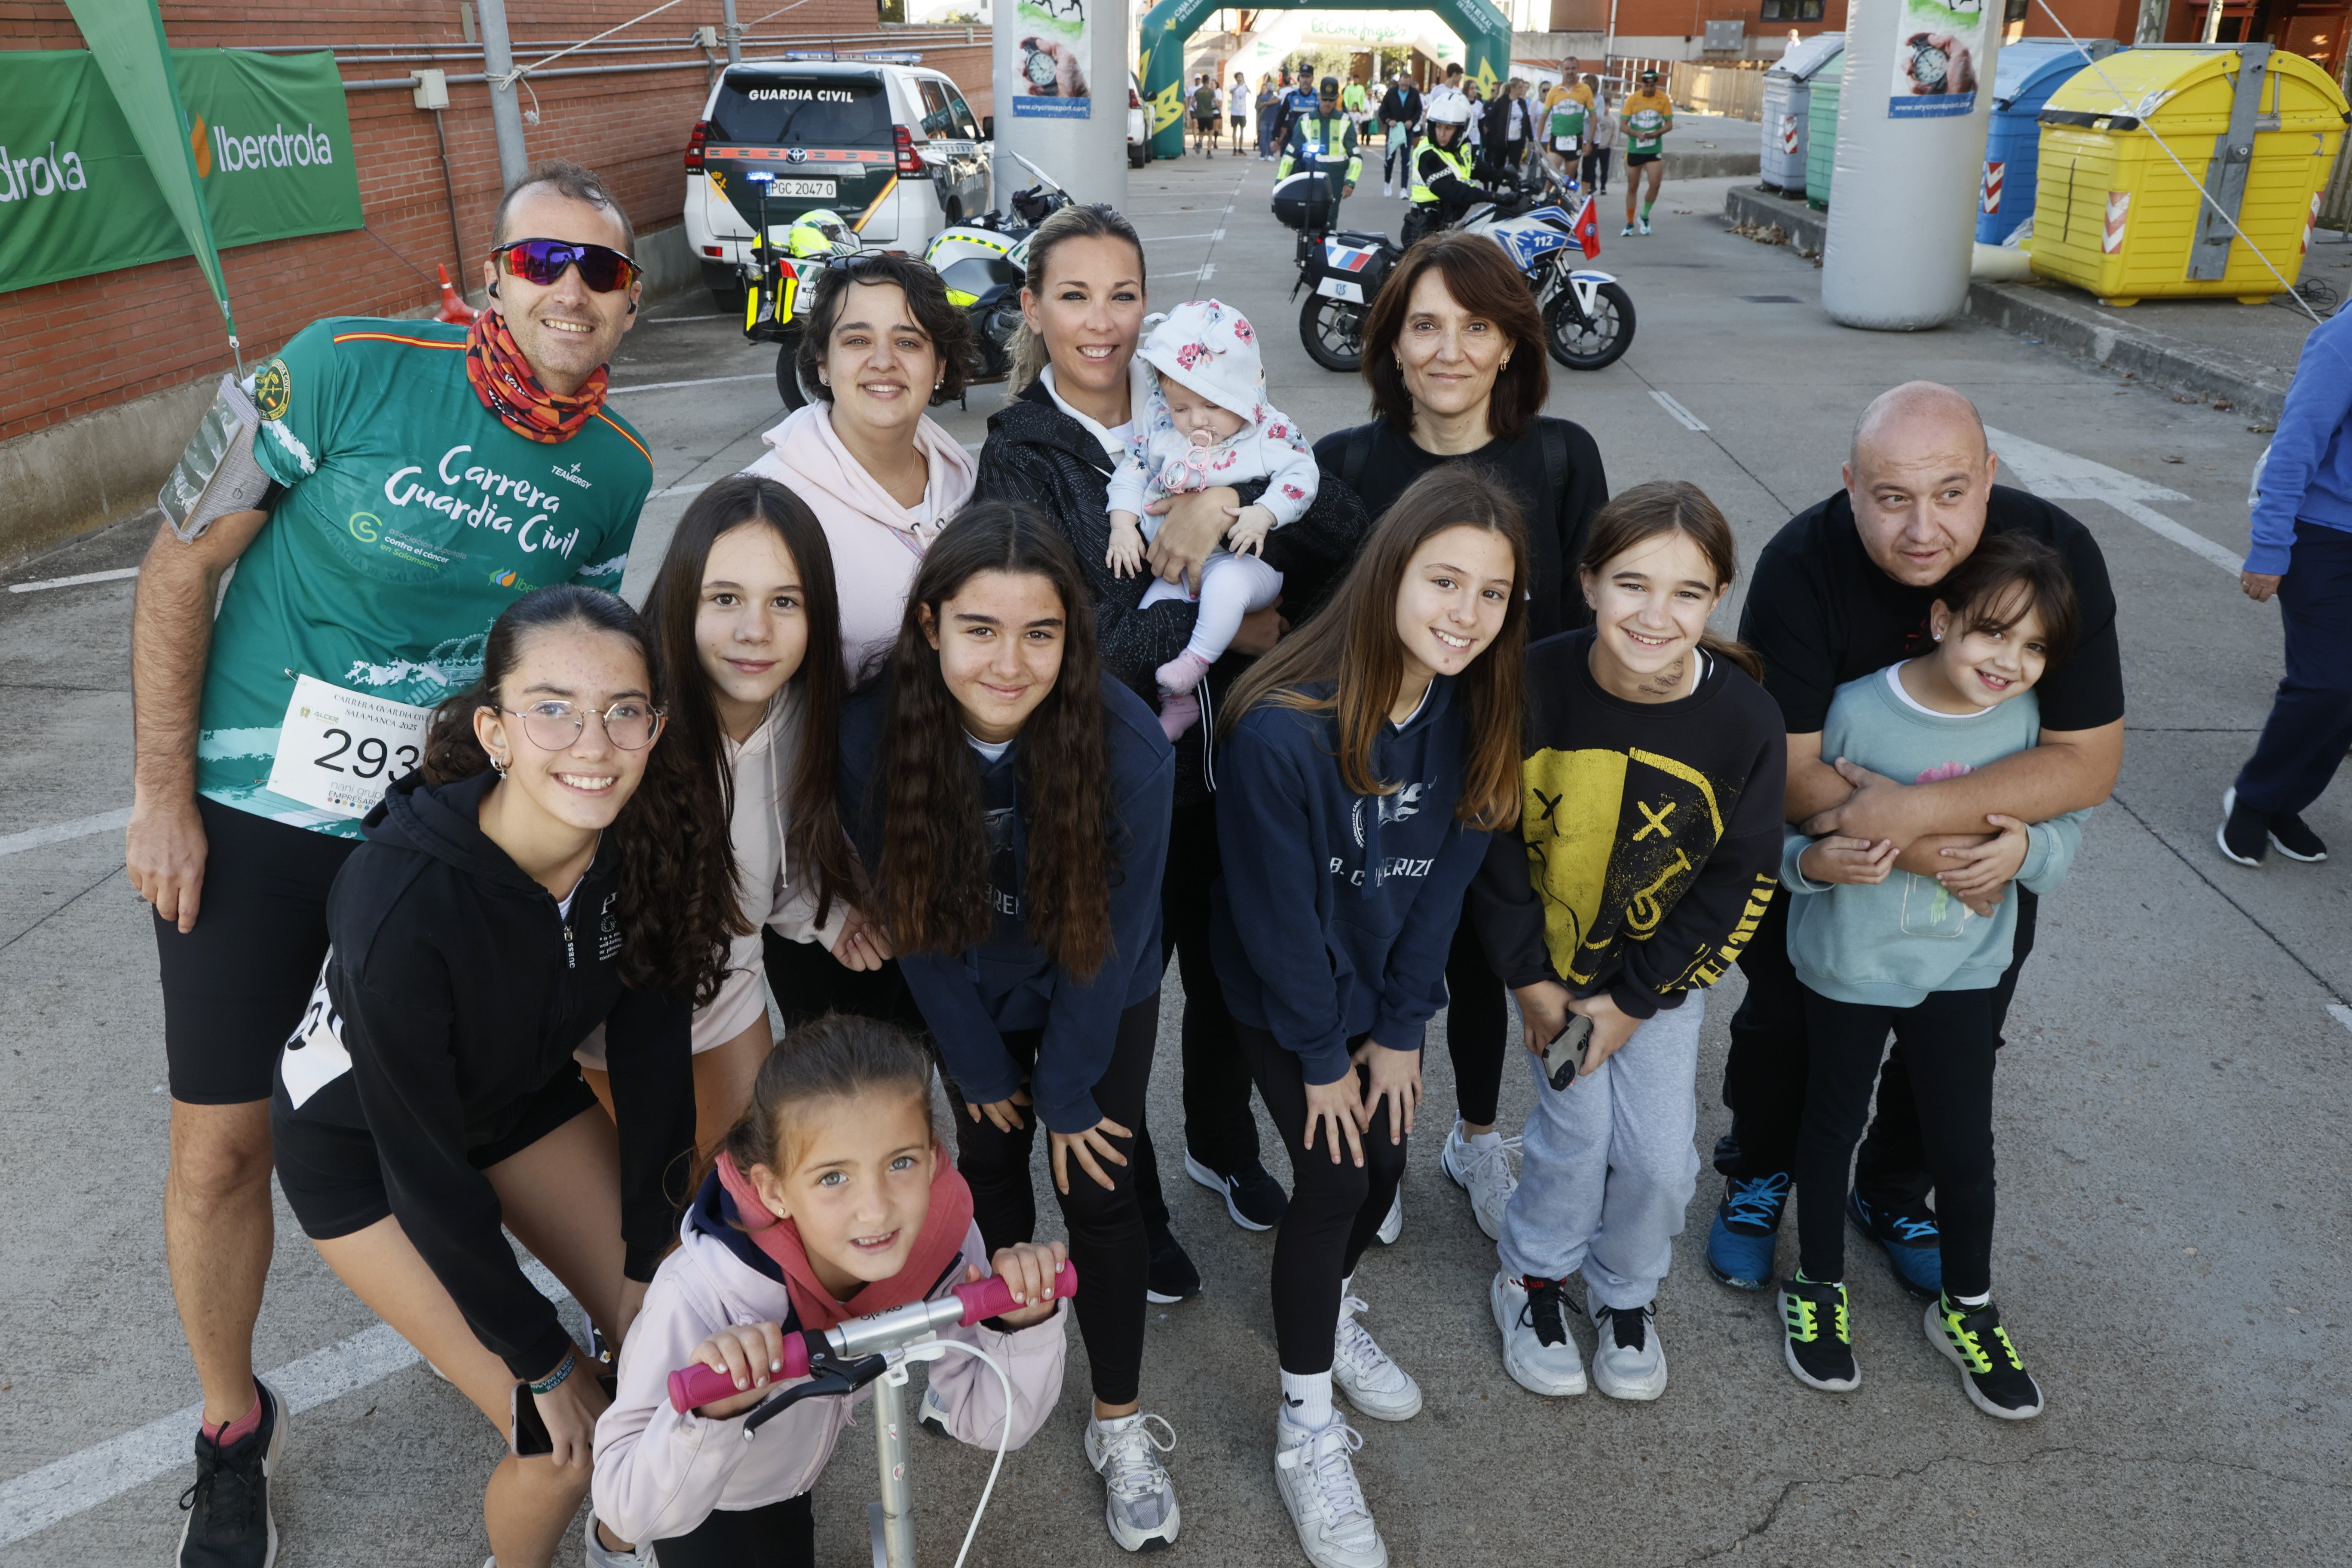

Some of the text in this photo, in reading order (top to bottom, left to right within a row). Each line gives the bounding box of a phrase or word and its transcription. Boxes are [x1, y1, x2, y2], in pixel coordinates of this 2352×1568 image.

[1311, 18, 1406, 41] El Corte Inglés
[1474, 8, 1492, 30] RURAL
[749, 89, 854, 103] GUARDIA CIVIL
[213, 123, 333, 172] Iberdrola
[772, 182, 791, 194] PGC
[796, 183, 823, 195] 2047
[1533, 235, 1553, 247] 112
[438, 445, 560, 513] Carrera
[551, 465, 592, 489] TEAMERGY
[384, 466, 579, 560] Guardia Civil
[384, 536, 450, 564] contra el cáncer
[389, 528, 467, 560] asociación española
[380, 543, 439, 570] en Salamanca
[514, 578, 539, 593] Iber
[334, 694, 374, 710] CARRERA
[314, 710, 339, 723] ALCER
[345, 709, 417, 731] SALAMANCA 2025
[314, 729, 420, 783] 293
[331, 781, 355, 793] nani
[1330, 857, 1344, 875] B.
